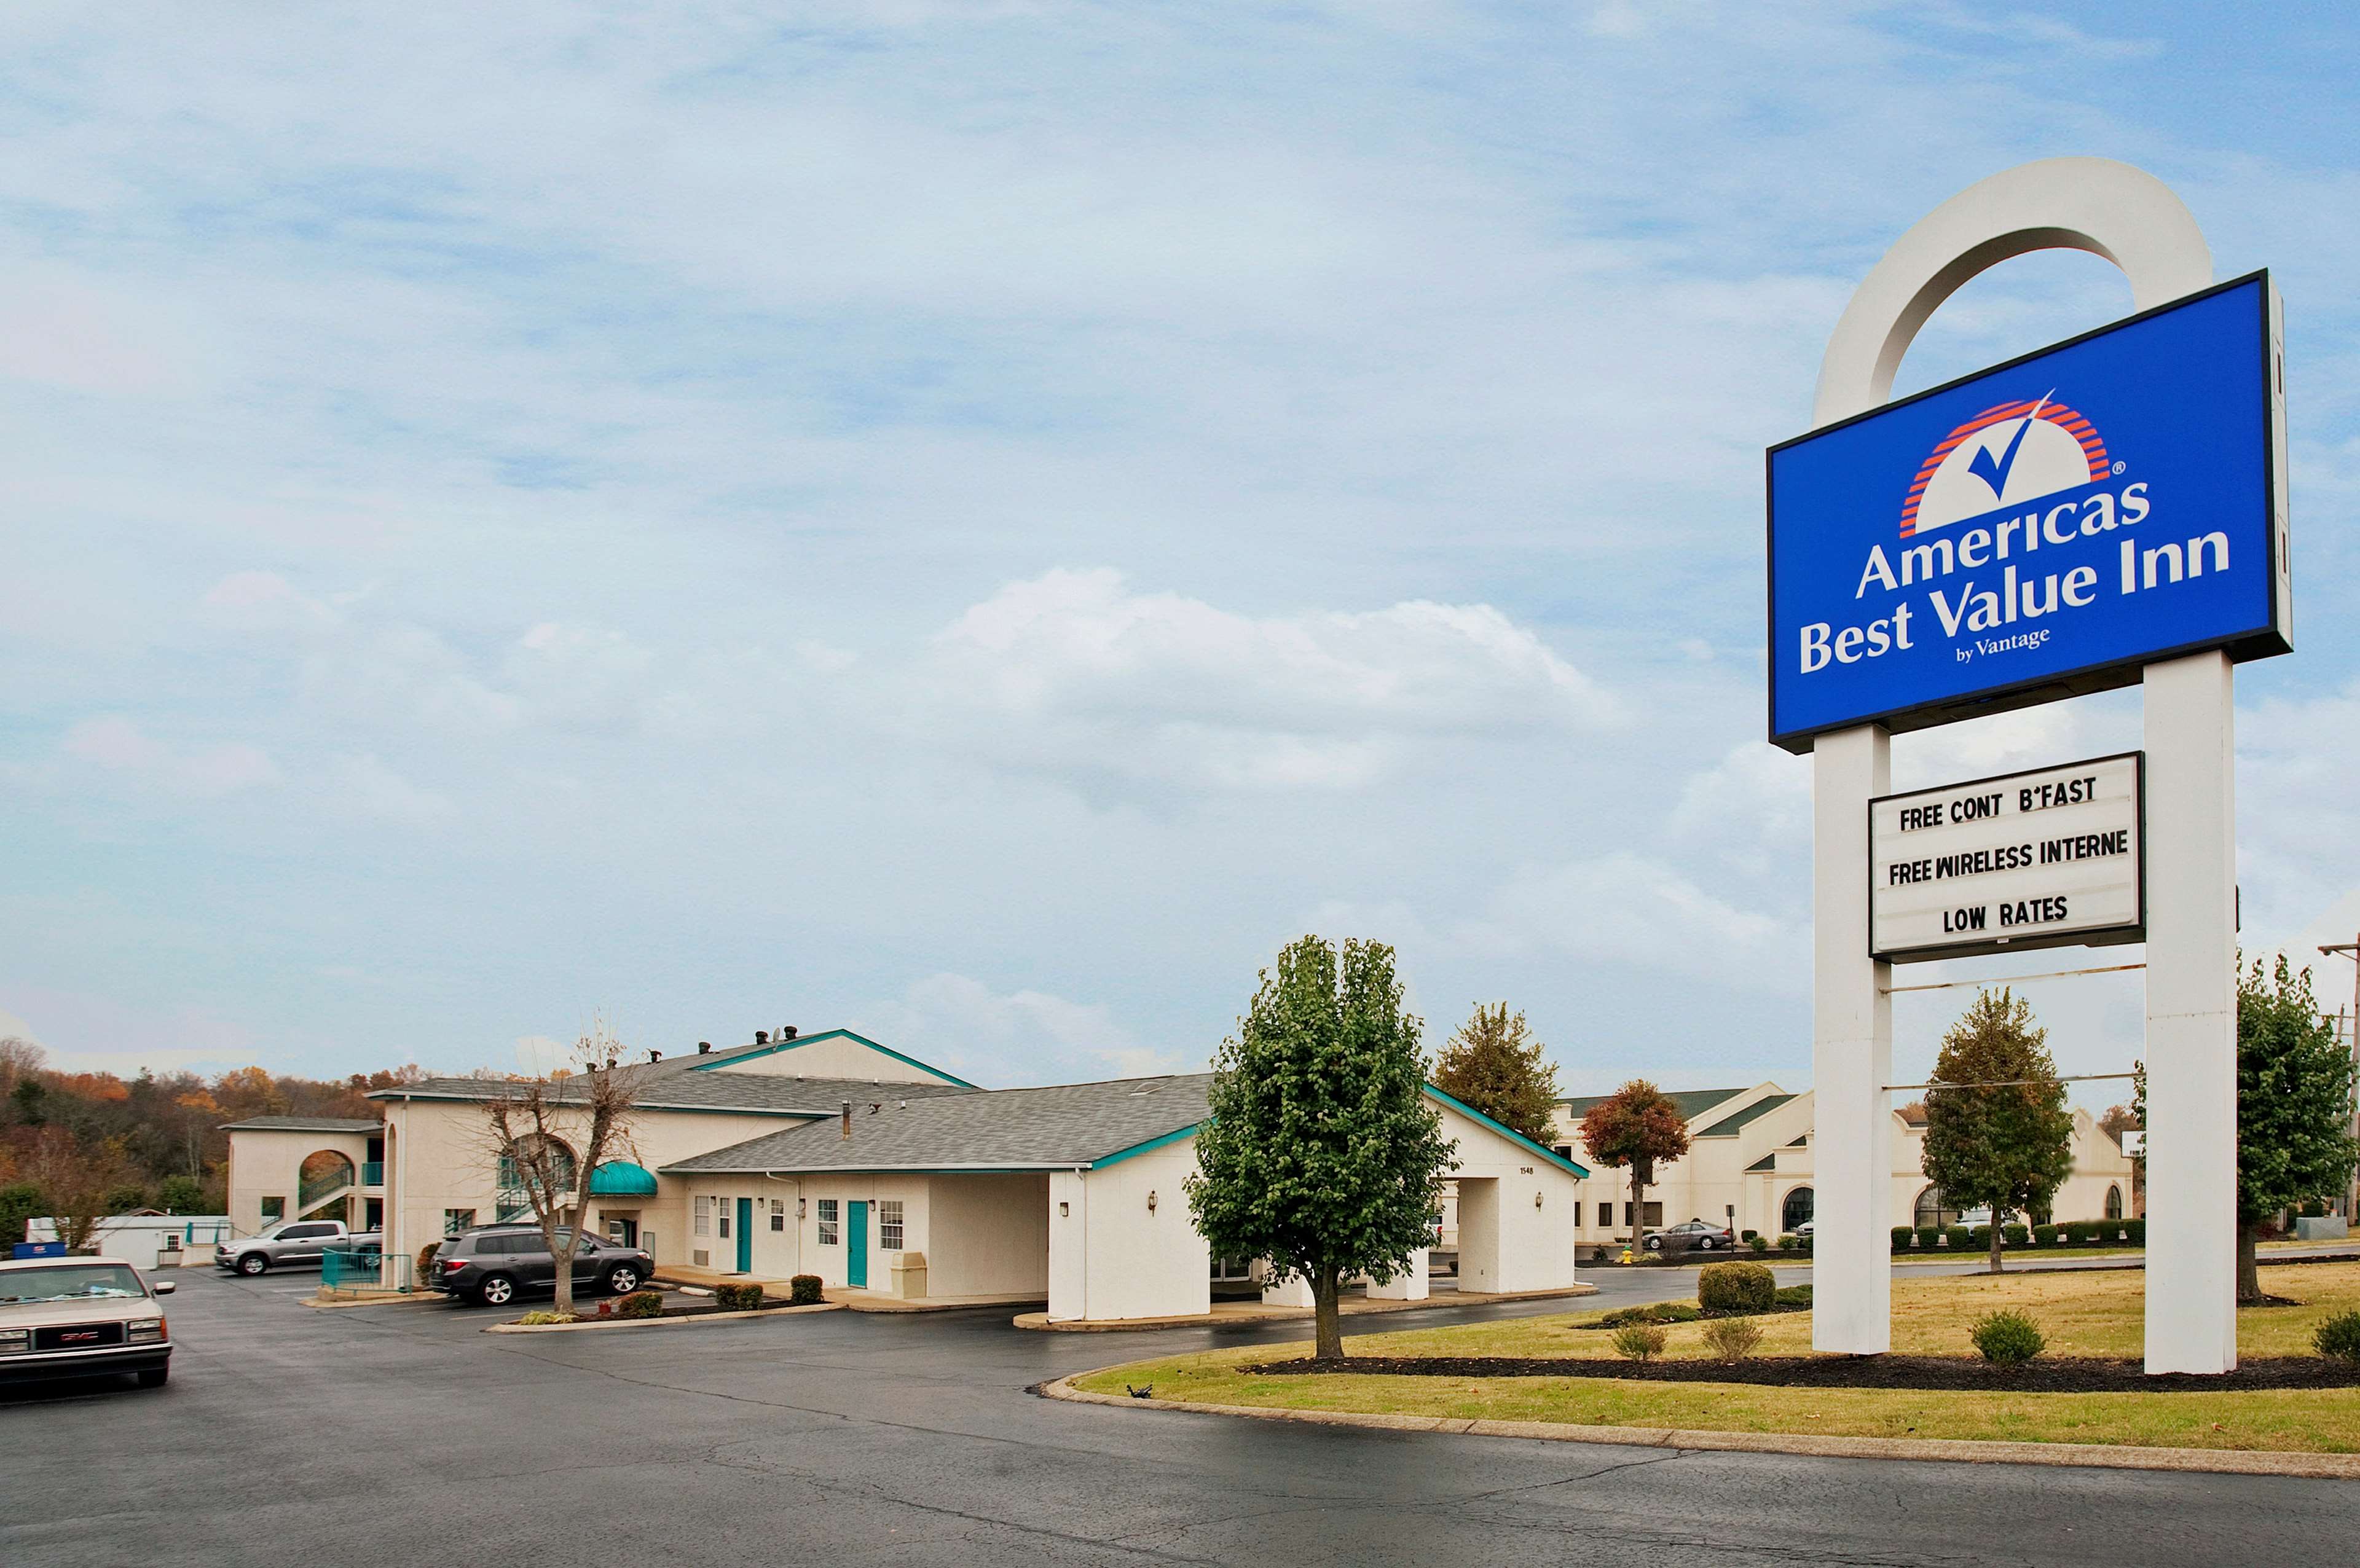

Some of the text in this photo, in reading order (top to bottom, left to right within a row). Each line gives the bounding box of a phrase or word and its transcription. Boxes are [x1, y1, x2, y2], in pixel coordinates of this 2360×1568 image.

[1855, 482, 2150, 599] Americas
[1800, 531, 2229, 674] Best Value Inn
[1956, 629, 2050, 664] by Vantage
[1900, 804, 1943, 831] FREE
[1951, 793, 2003, 824] CONT
[1890, 829, 2128, 886] FREE WIRELESS INTERNE
[1943, 896, 2067, 933] LOW RATES
[60, 1331, 98, 1341] GMC
